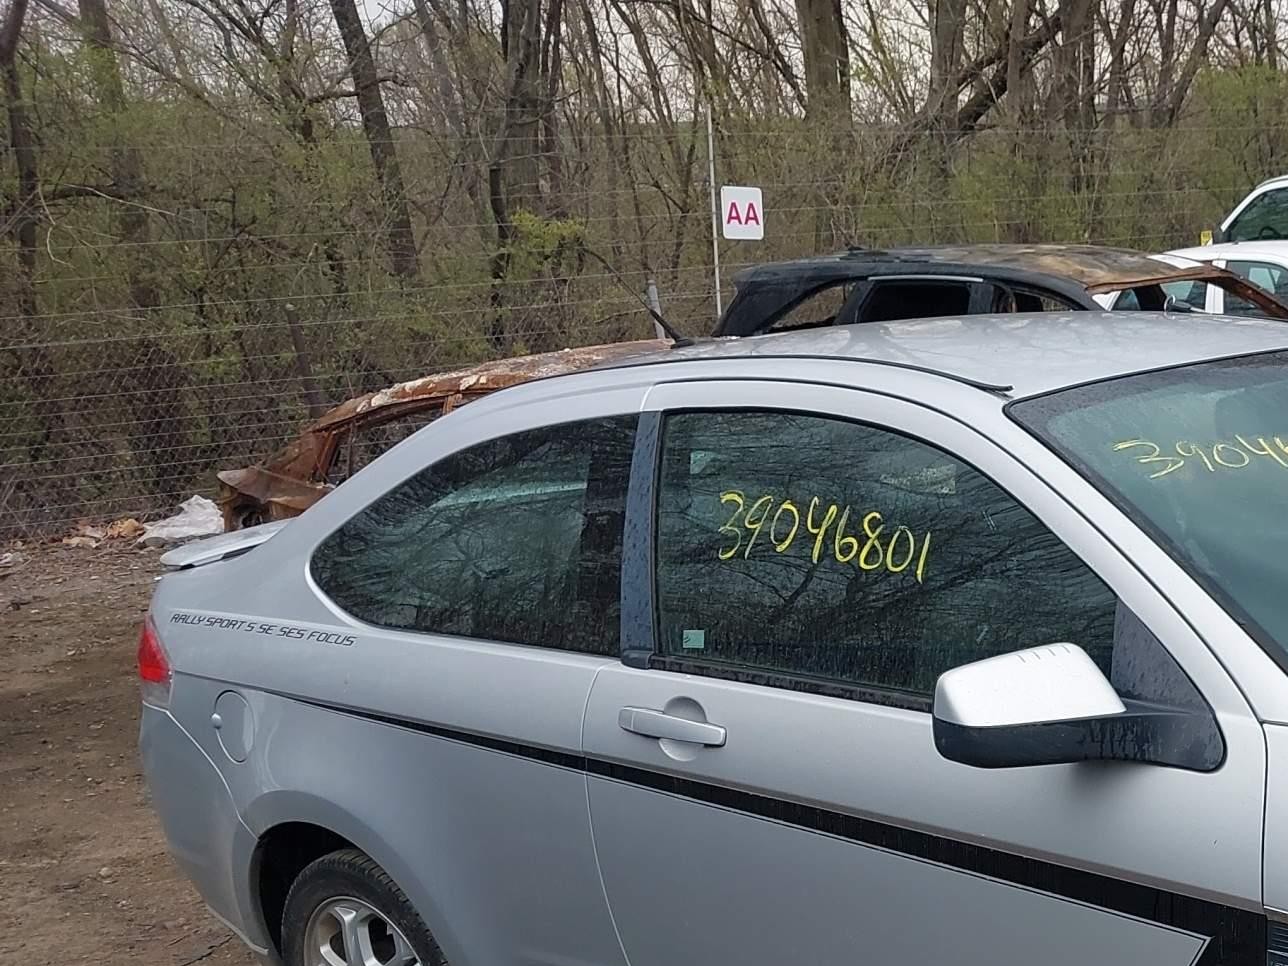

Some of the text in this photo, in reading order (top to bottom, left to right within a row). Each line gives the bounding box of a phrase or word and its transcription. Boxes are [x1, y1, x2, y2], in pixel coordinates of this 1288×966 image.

[726, 201, 760, 226] AA
[718, 489, 931, 585] 39046801
[170, 613, 205, 625] RALLY
[206, 617, 246, 630] SPORT
[256, 623, 277, 635] SE
[277, 626, 307, 639] SES
[306, 631, 357, 647] FOCUS
